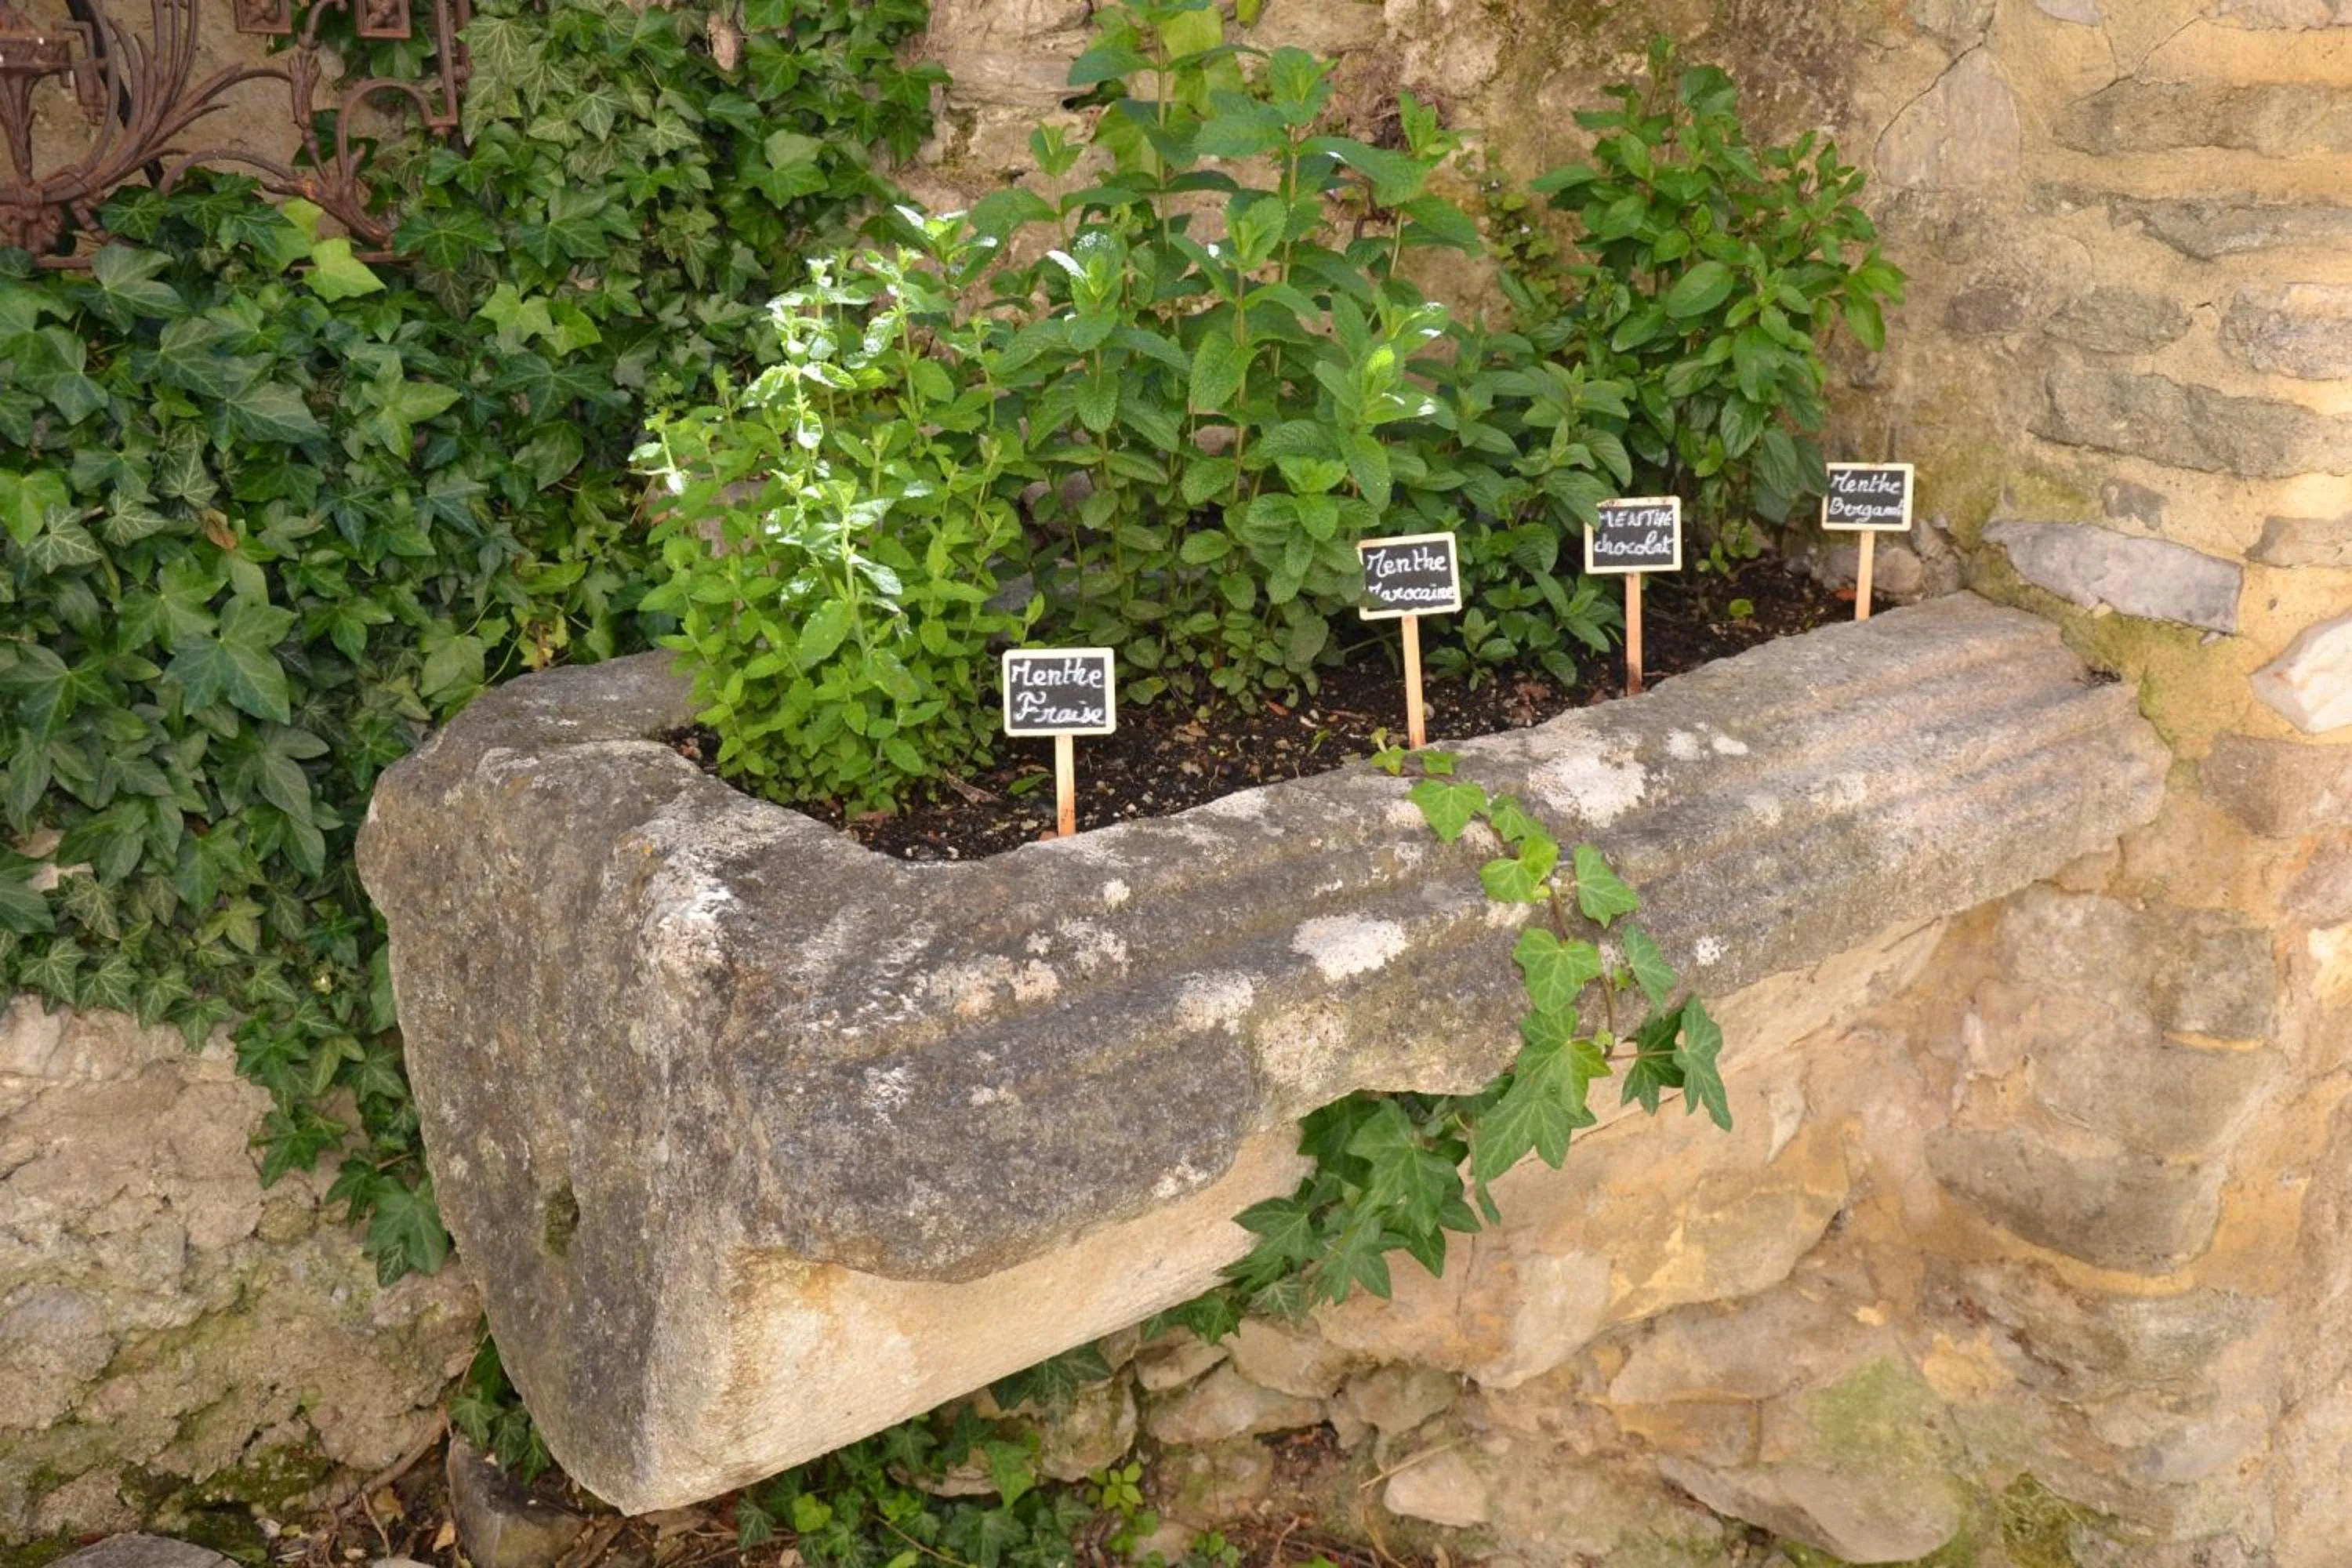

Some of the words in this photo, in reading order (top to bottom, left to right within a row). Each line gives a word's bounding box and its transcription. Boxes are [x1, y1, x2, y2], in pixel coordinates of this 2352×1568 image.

[1831, 470, 1900, 494] Menthe
[1595, 530, 1674, 555] chocolat
[1367, 546, 1447, 577] Menthe
[1011, 659, 1105, 688] Menthe
[1014, 691, 1105, 724] Fraise
